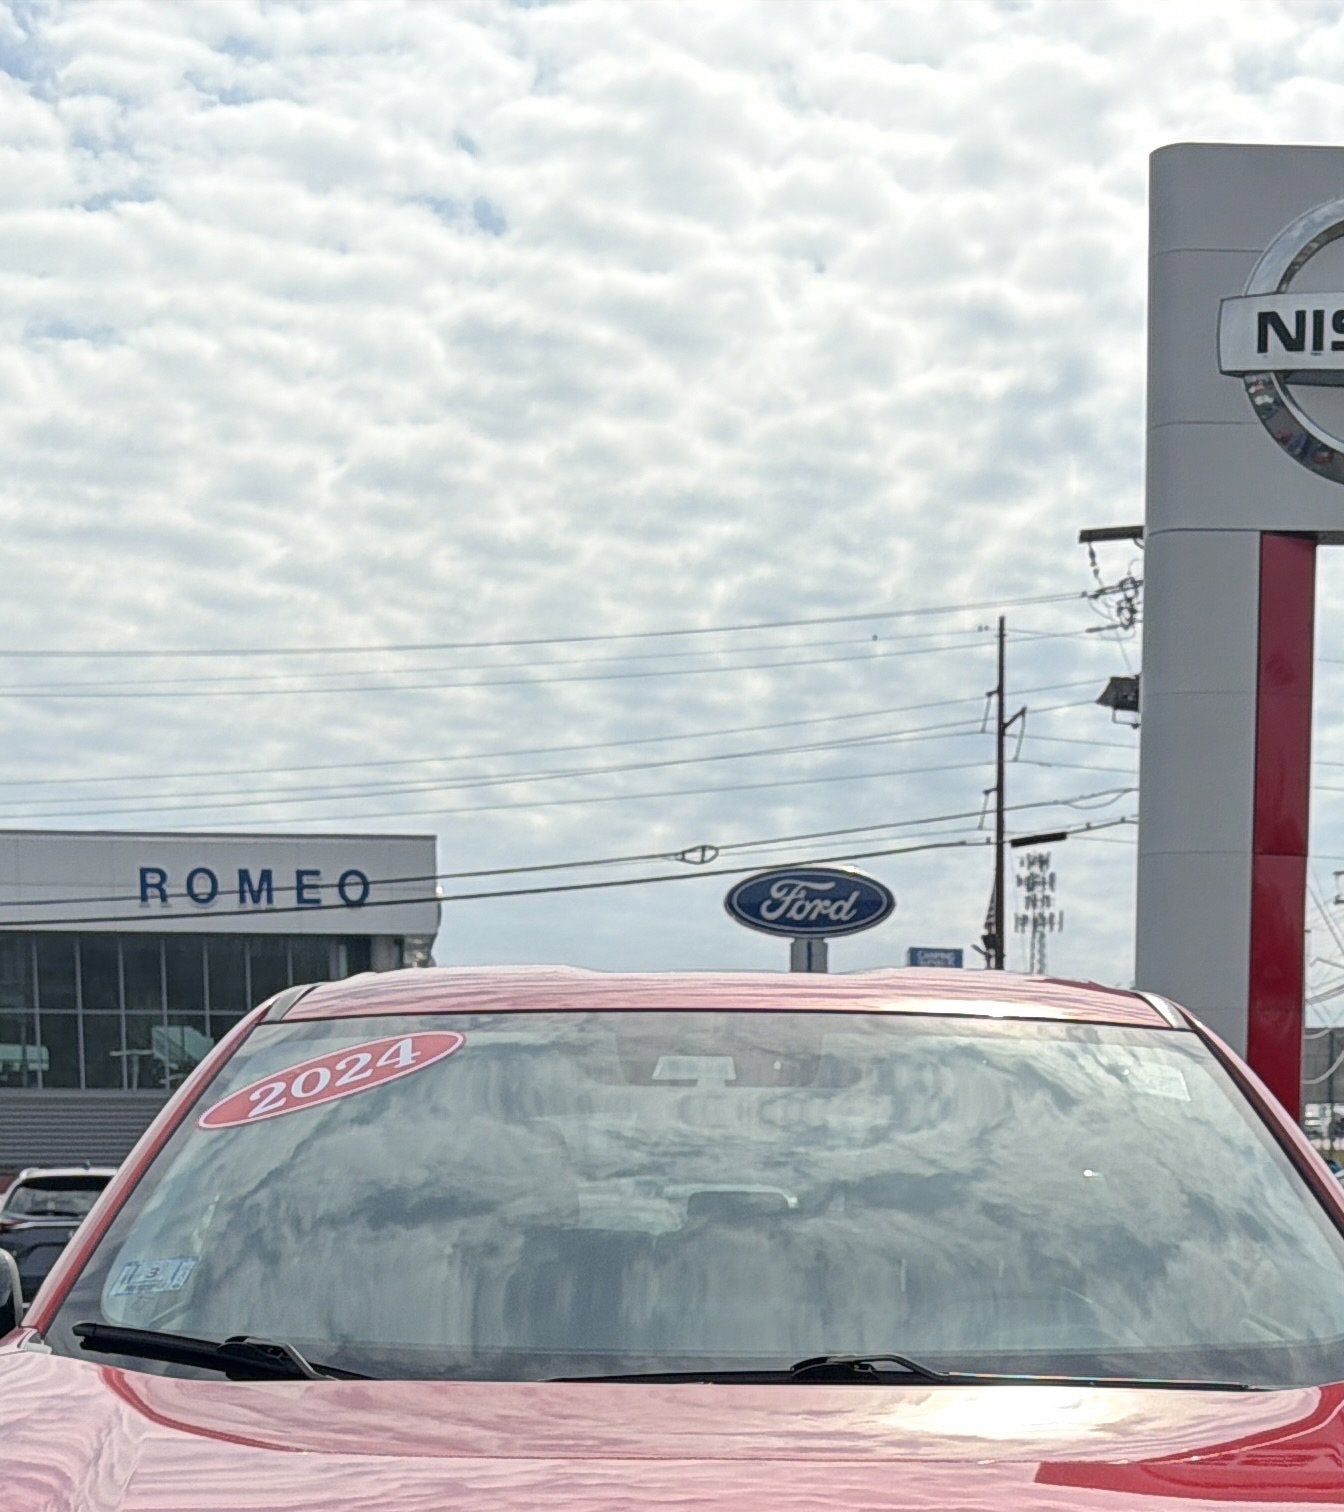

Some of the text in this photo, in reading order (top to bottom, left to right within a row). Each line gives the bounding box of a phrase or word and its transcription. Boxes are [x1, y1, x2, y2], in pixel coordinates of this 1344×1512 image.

[139, 867, 370, 907] ROMEO
[760, 879, 860, 921] Ford
[248, 1038, 421, 1117] 2024
